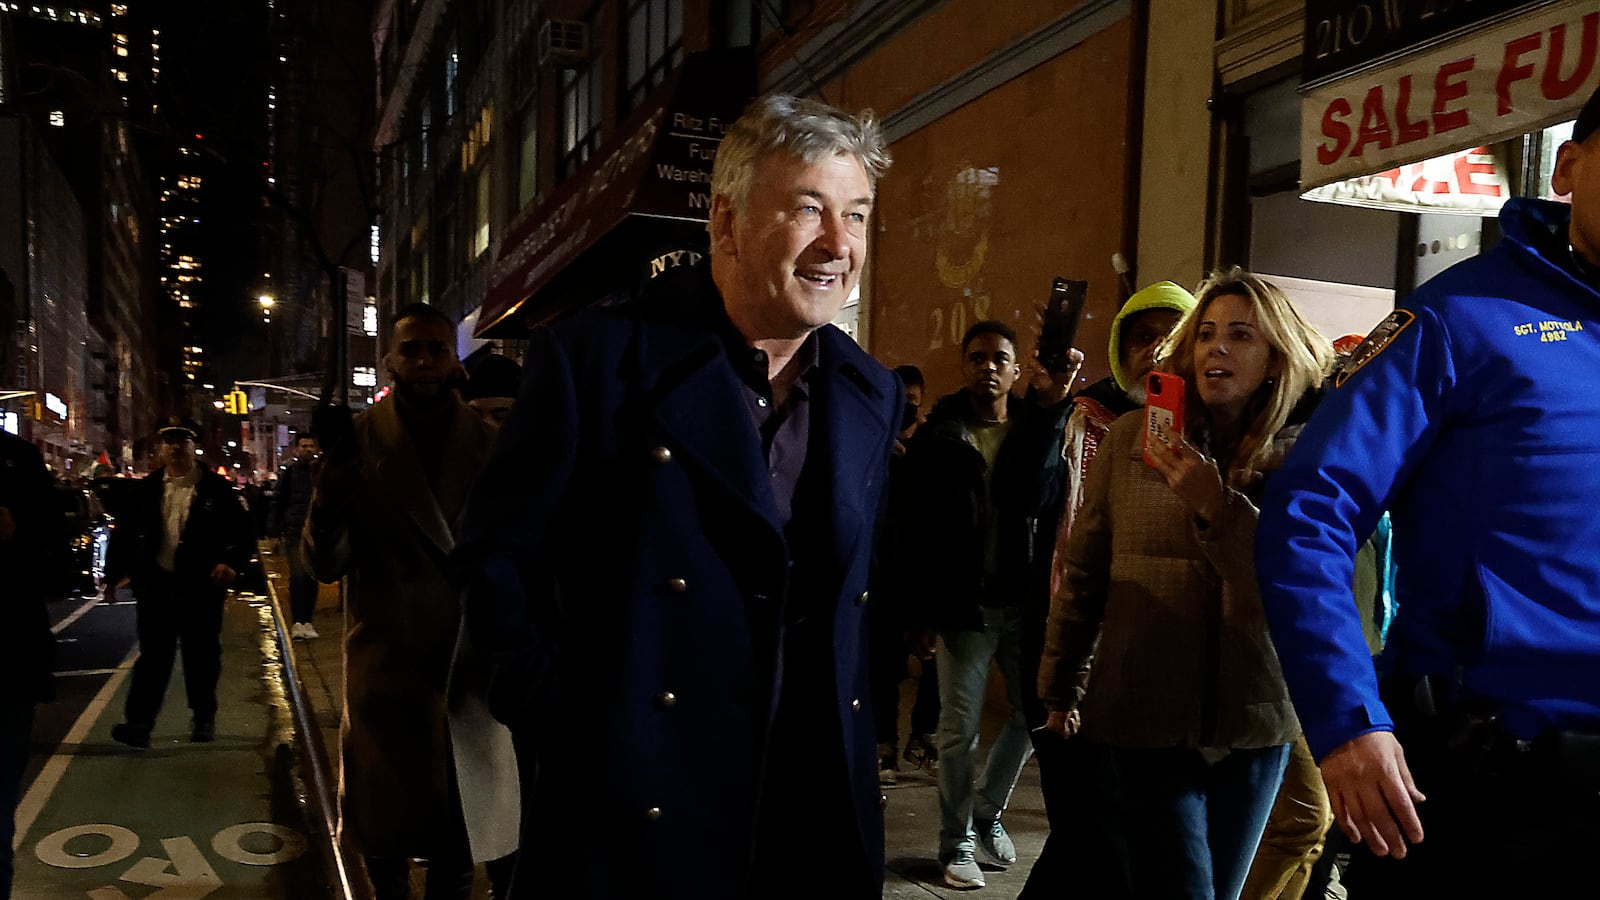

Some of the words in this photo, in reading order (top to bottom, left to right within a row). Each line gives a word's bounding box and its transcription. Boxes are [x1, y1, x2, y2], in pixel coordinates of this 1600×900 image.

[1315, 3, 1373, 60] 210
[1317, 57, 1476, 166] SALE
[1496, 11, 1600, 117] FU
[673, 112, 704, 131] Ritz
[1513, 323, 1538, 337] SGT.
